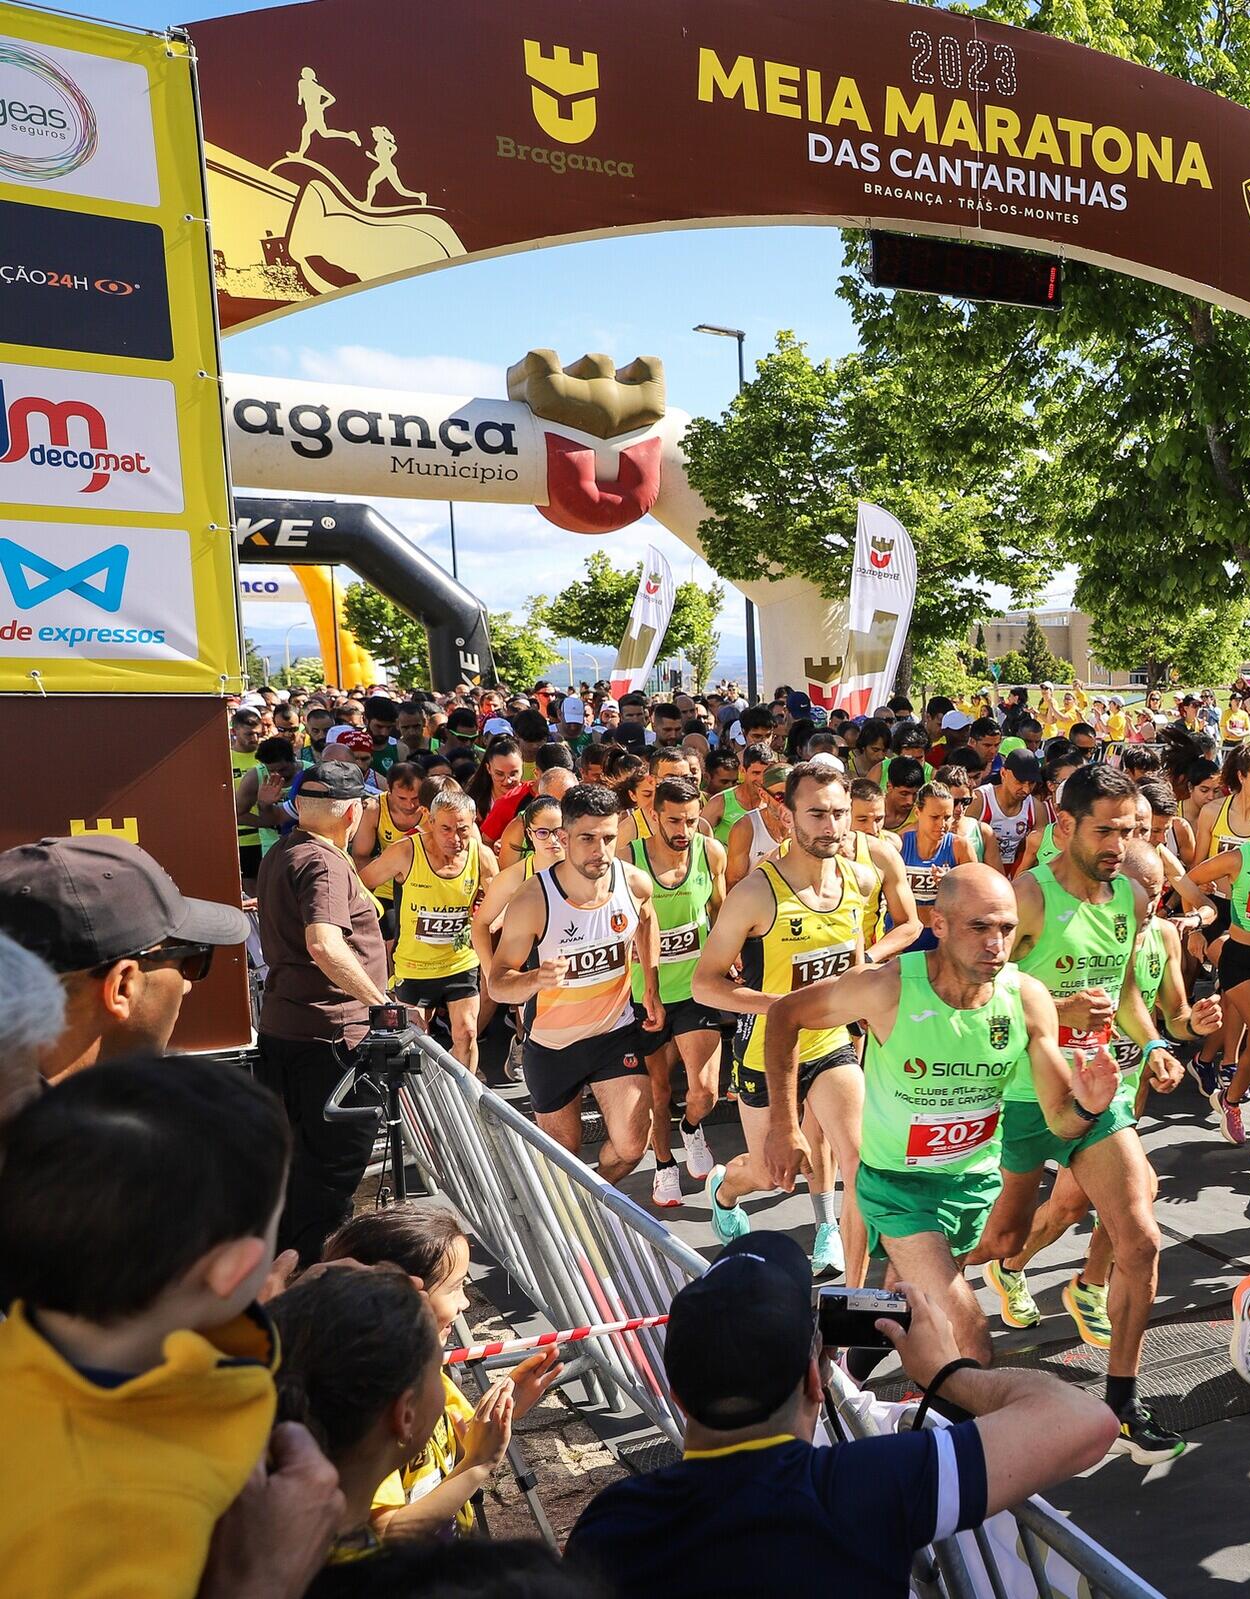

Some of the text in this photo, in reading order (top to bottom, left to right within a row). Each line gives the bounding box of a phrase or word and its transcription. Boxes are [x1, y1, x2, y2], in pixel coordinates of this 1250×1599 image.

[909, 29, 1018, 97] 2023
[11, 124, 66, 140] seguros
[698, 47, 1213, 190] MEIA MARATONA
[496, 135, 635, 180] Bragança
[807, 132, 1128, 212] DAS CANTARINHAS
[863, 183, 944, 206] BRAGANÇA
[225, 397, 519, 460] agança
[29, 442, 152, 475] decomat
[390, 455, 519, 484] Município
[238, 517, 314, 547] KE
[240, 580, 279, 594] nco
[0, 620, 166, 648] de expressos
[422, 919, 464, 932] 1425
[661, 931, 695, 951] 429
[567, 944, 619, 972] 1021
[799, 953, 851, 982] 1375
[894, 1090, 937, 1106] MACEDO
[940, 1098, 954, 1107] DE
[914, 1087, 948, 1096] CLUBE
[926, 1120, 986, 1147] 202
